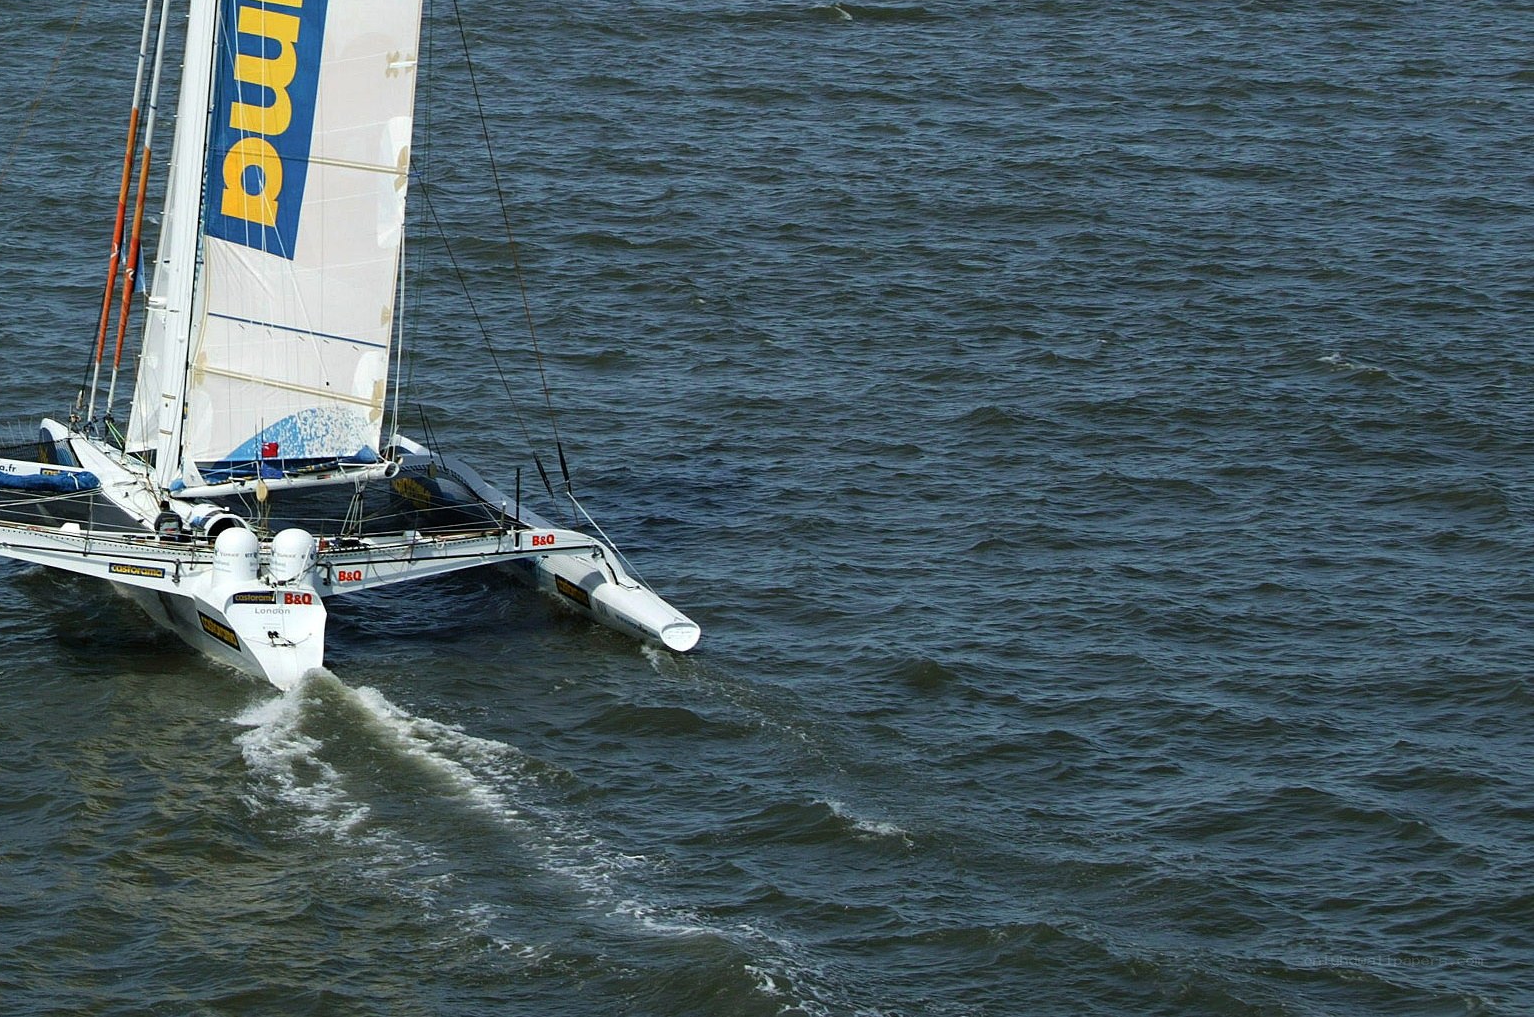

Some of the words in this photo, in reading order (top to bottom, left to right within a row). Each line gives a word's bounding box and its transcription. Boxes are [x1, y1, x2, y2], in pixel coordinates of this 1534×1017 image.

[532, 534, 555, 547] B&Q
[111, 565, 163, 577] castorama
[338, 570, 362, 582] B&Q
[284, 592, 312, 605] B&Q
